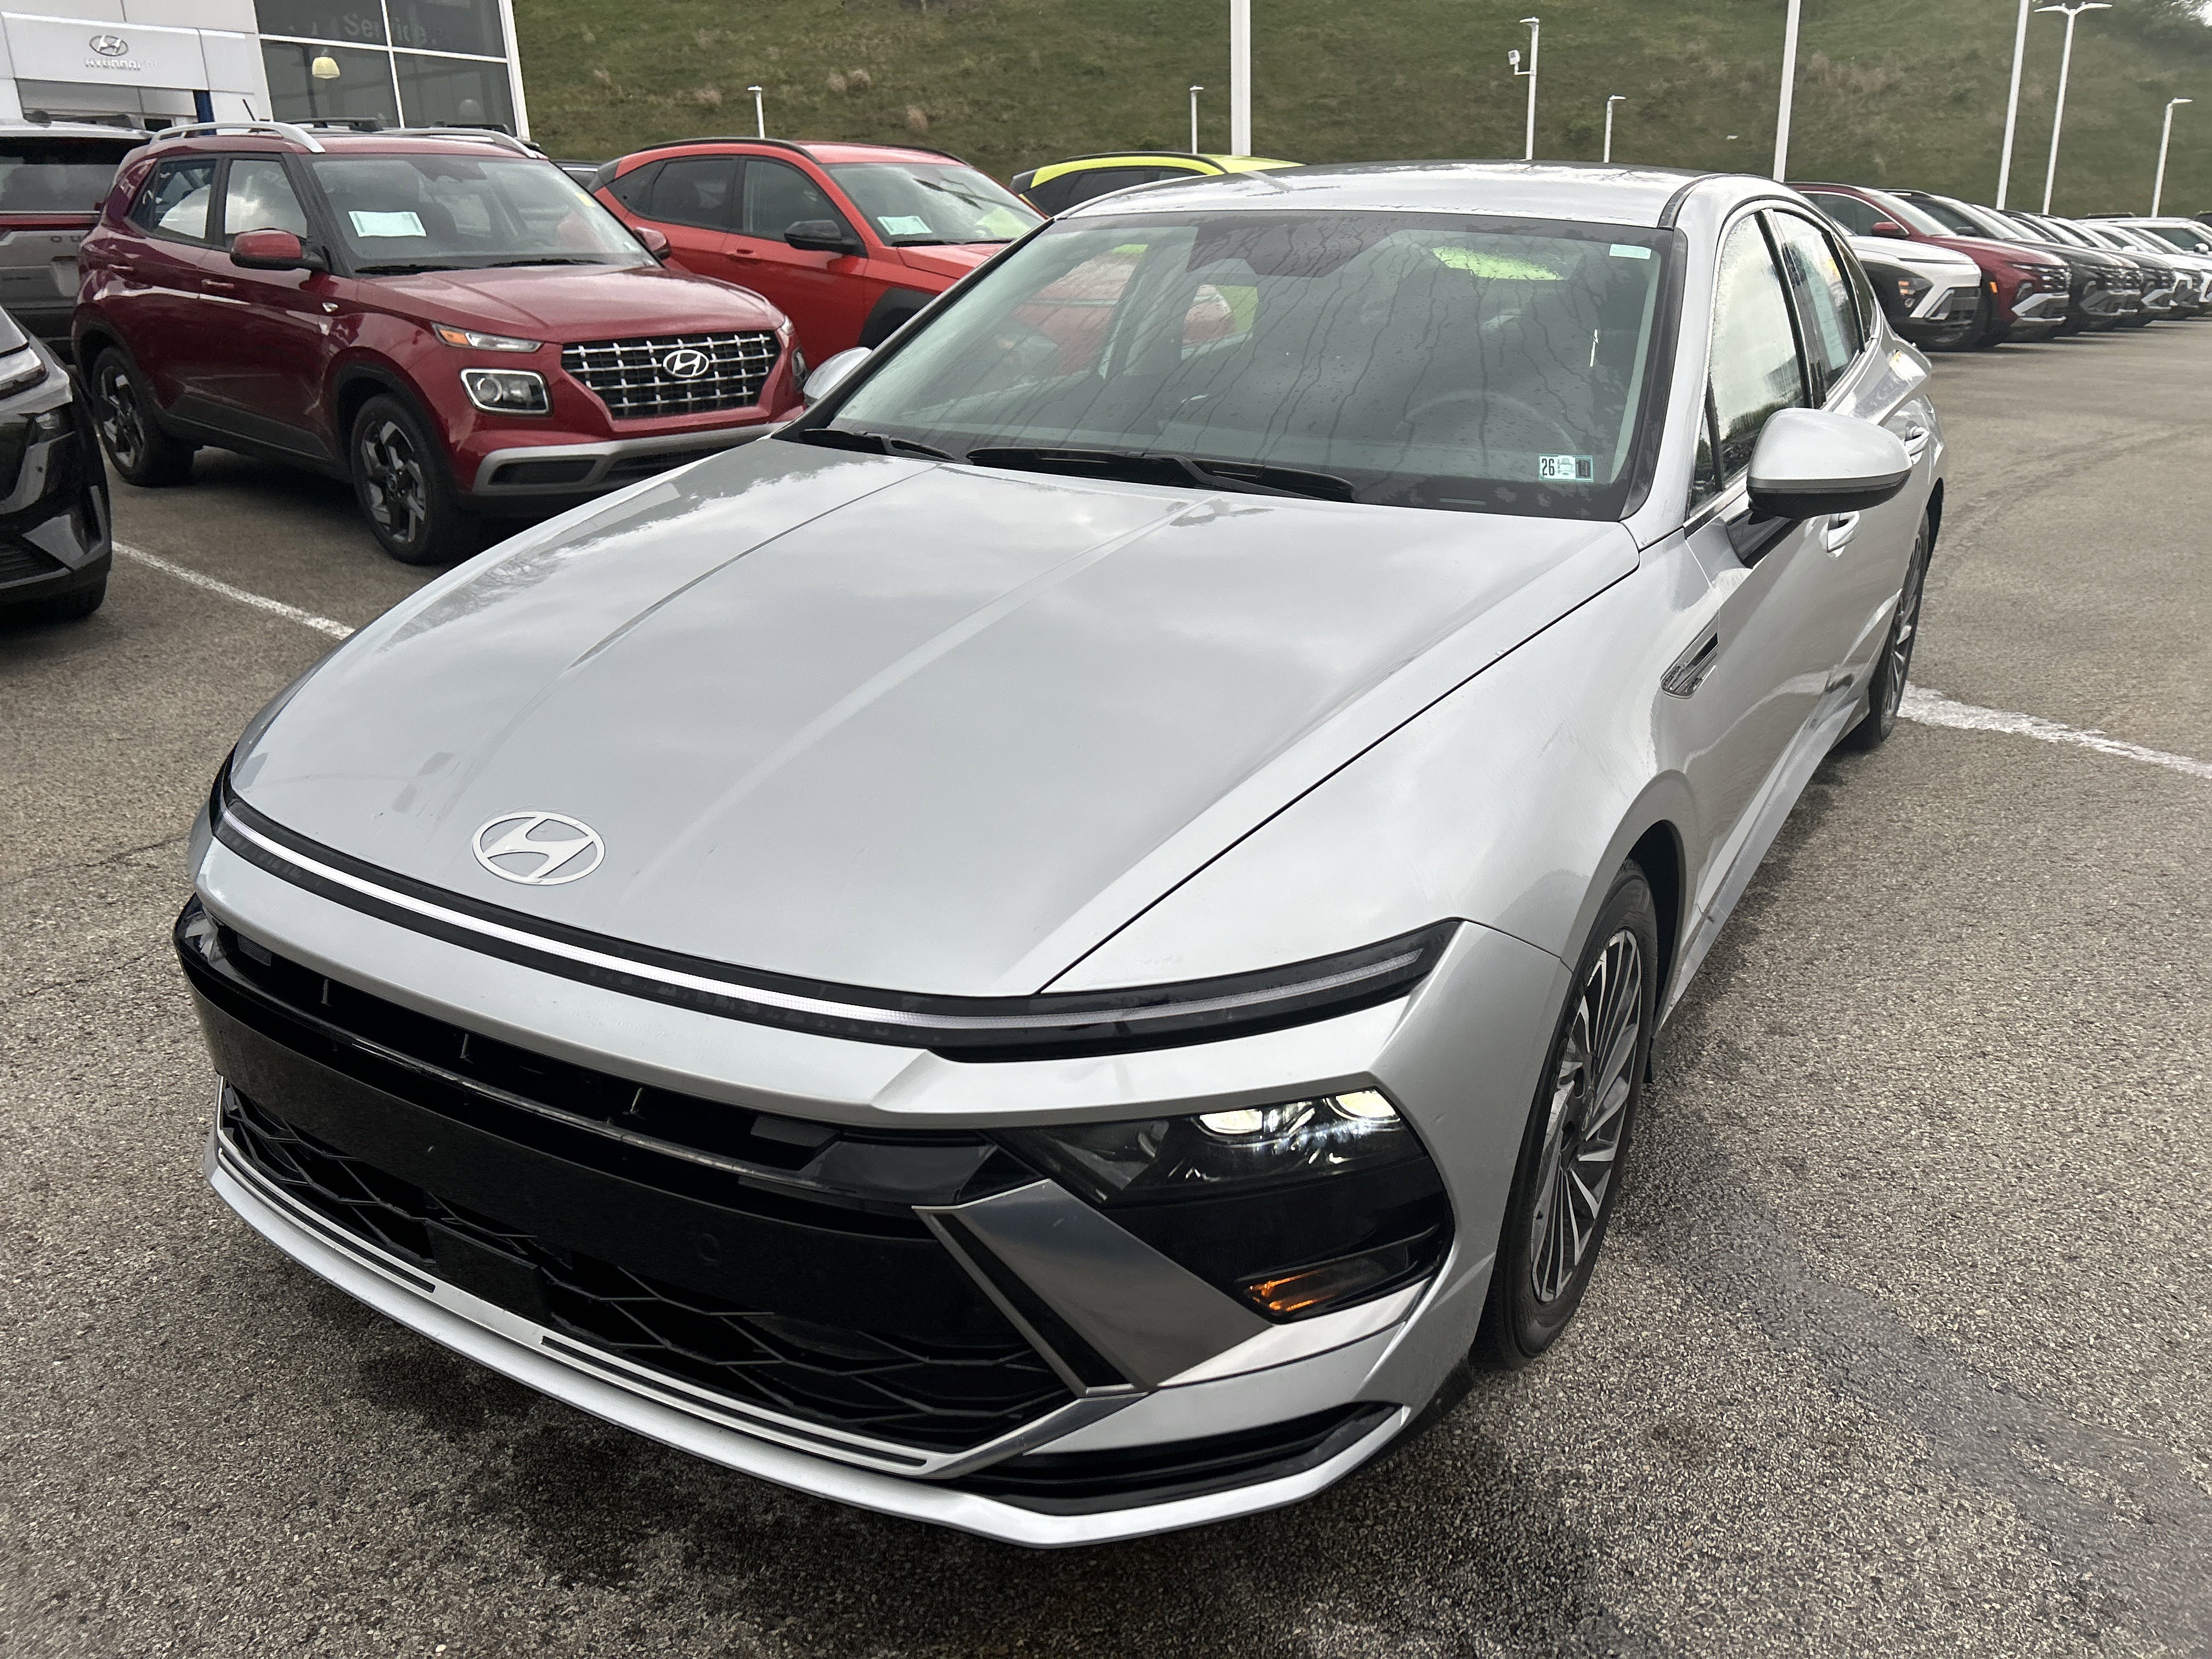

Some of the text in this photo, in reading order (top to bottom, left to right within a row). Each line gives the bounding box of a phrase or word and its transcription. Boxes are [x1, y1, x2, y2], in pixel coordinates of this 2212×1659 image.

[343, 13, 427, 46] Serice
[84, 57, 142, 71] HYUNDAI
[1542, 458, 1555, 476] 26
